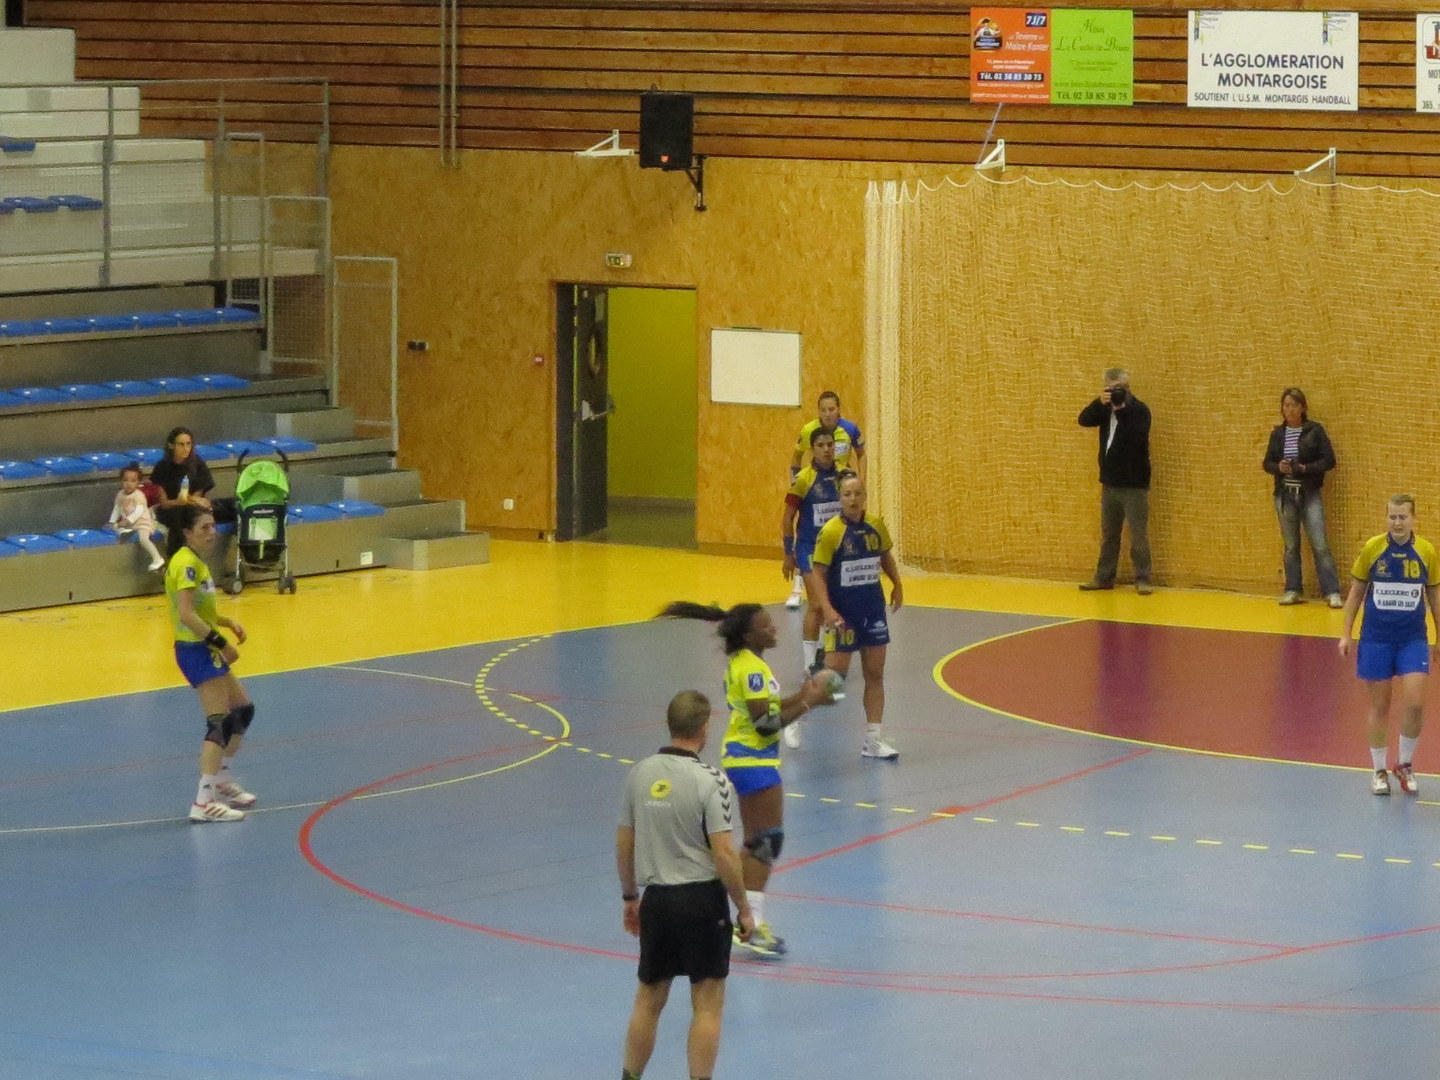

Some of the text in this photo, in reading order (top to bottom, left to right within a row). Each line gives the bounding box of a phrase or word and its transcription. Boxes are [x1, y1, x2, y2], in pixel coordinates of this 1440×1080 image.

[1201, 53, 1344, 69] L'AGGLOMERATION
[980, 72, 992, 80] Tél.
[1217, 73, 1327, 89] MONTARGOISE
[1194, 92, 1229, 102] SOUTIENT
[1265, 94, 1309, 104] MONTARGIS
[1312, 95, 1351, 105] HANDBALL
